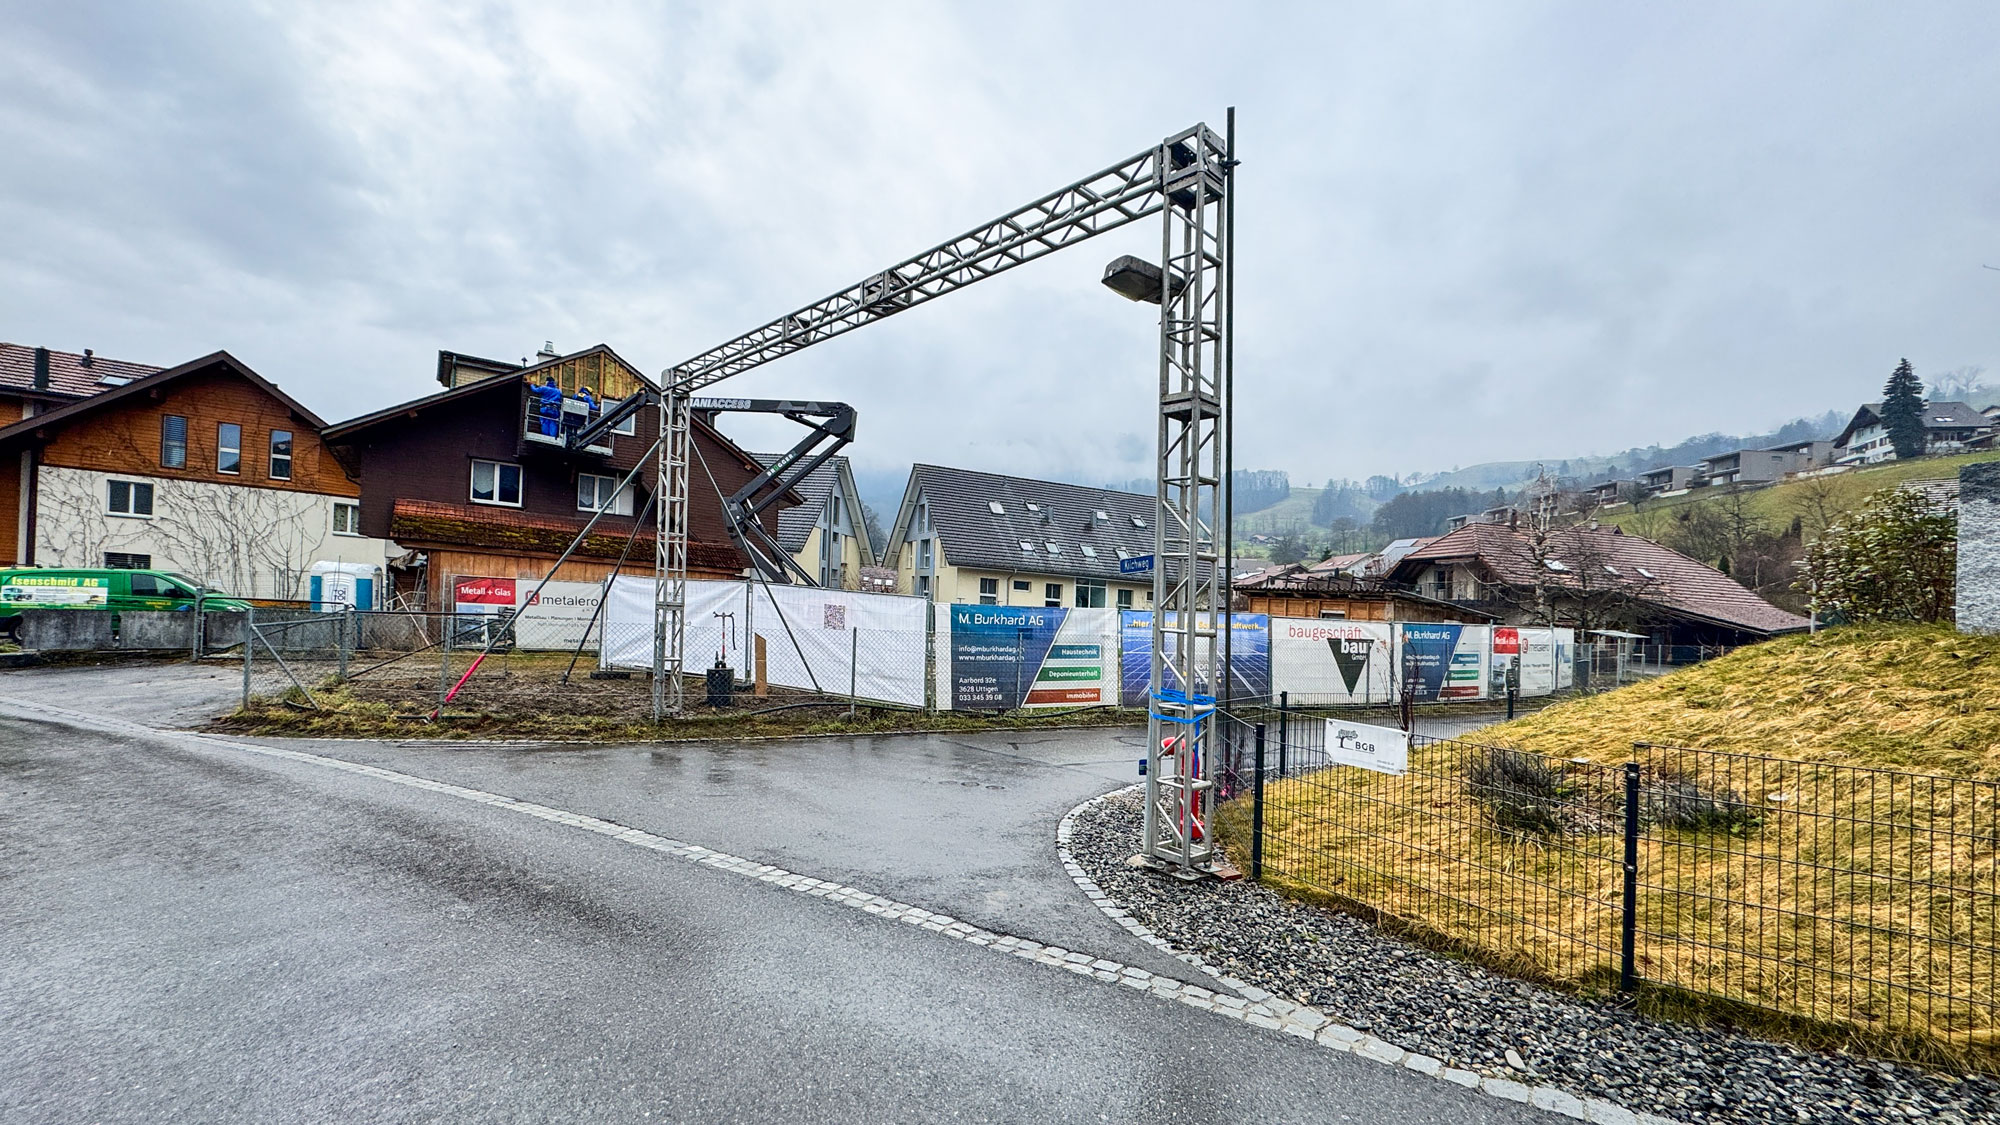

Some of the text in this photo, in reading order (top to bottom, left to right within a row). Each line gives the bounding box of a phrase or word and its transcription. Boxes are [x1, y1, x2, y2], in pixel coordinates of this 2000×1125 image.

[12, 576, 99, 587] Isenschmid AG
[461, 587, 486, 595] Metall
[494, 588, 511, 597] Glas
[542, 596, 599, 606] metalero
[959, 613, 1043, 625] M. Burkhard AG
[1289, 625, 1361, 641] baugeschäft
[1355, 741, 1375, 752] BGB
